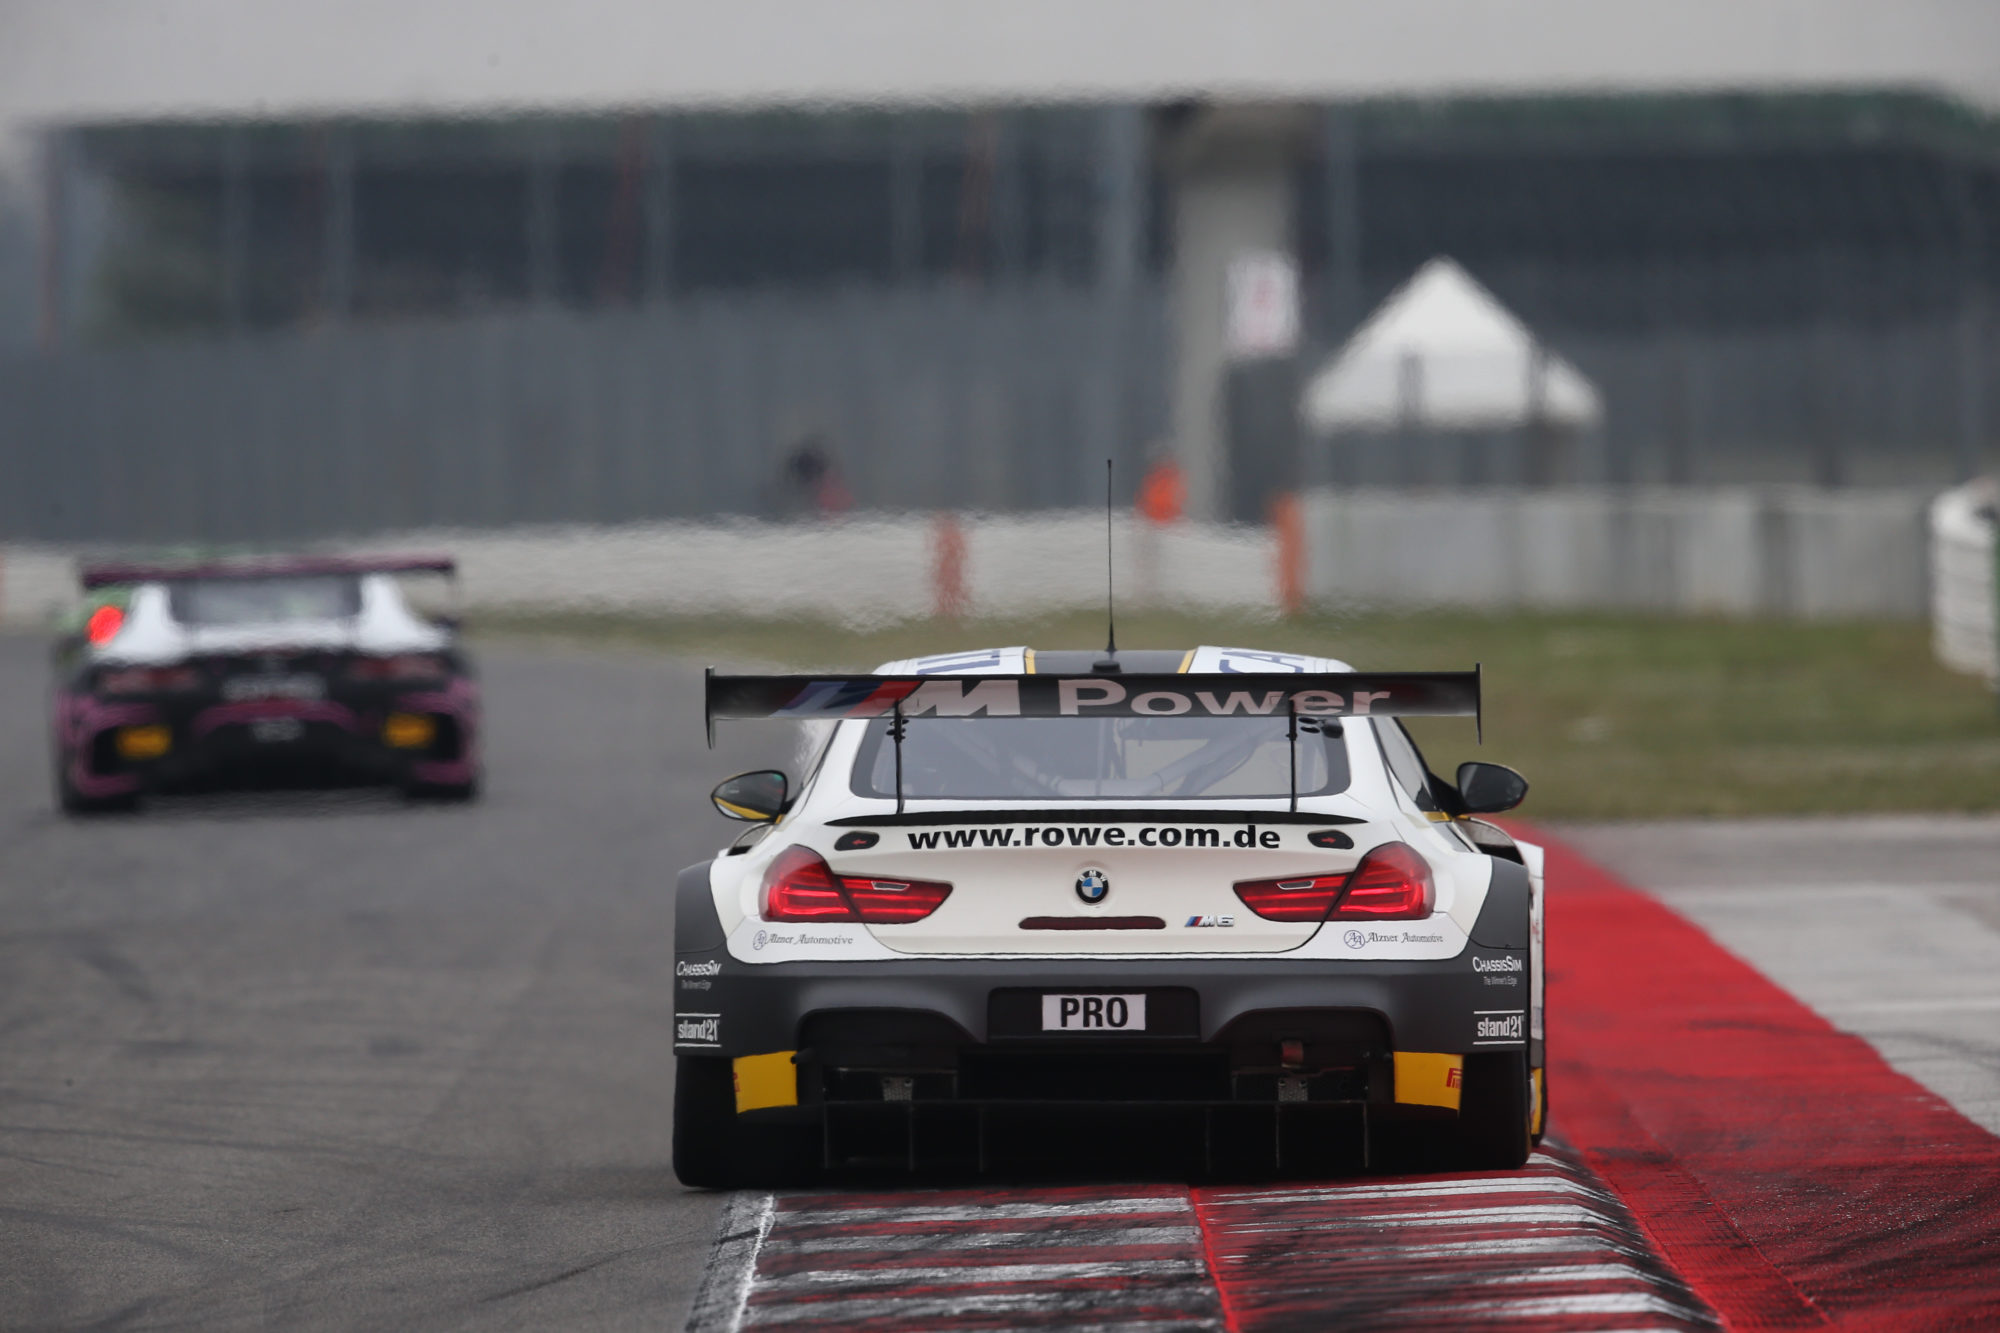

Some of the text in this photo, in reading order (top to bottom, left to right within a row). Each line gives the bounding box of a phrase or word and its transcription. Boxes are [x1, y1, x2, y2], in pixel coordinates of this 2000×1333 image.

[880, 679, 1391, 716] M Power
[907, 825, 1281, 849] www.rowe.com.de
[1198, 915, 1235, 927] M6
[794, 933, 853, 945] Automotive
[1401, 932, 1443, 943] Automotive
[1060, 997, 1129, 1029] PRO
